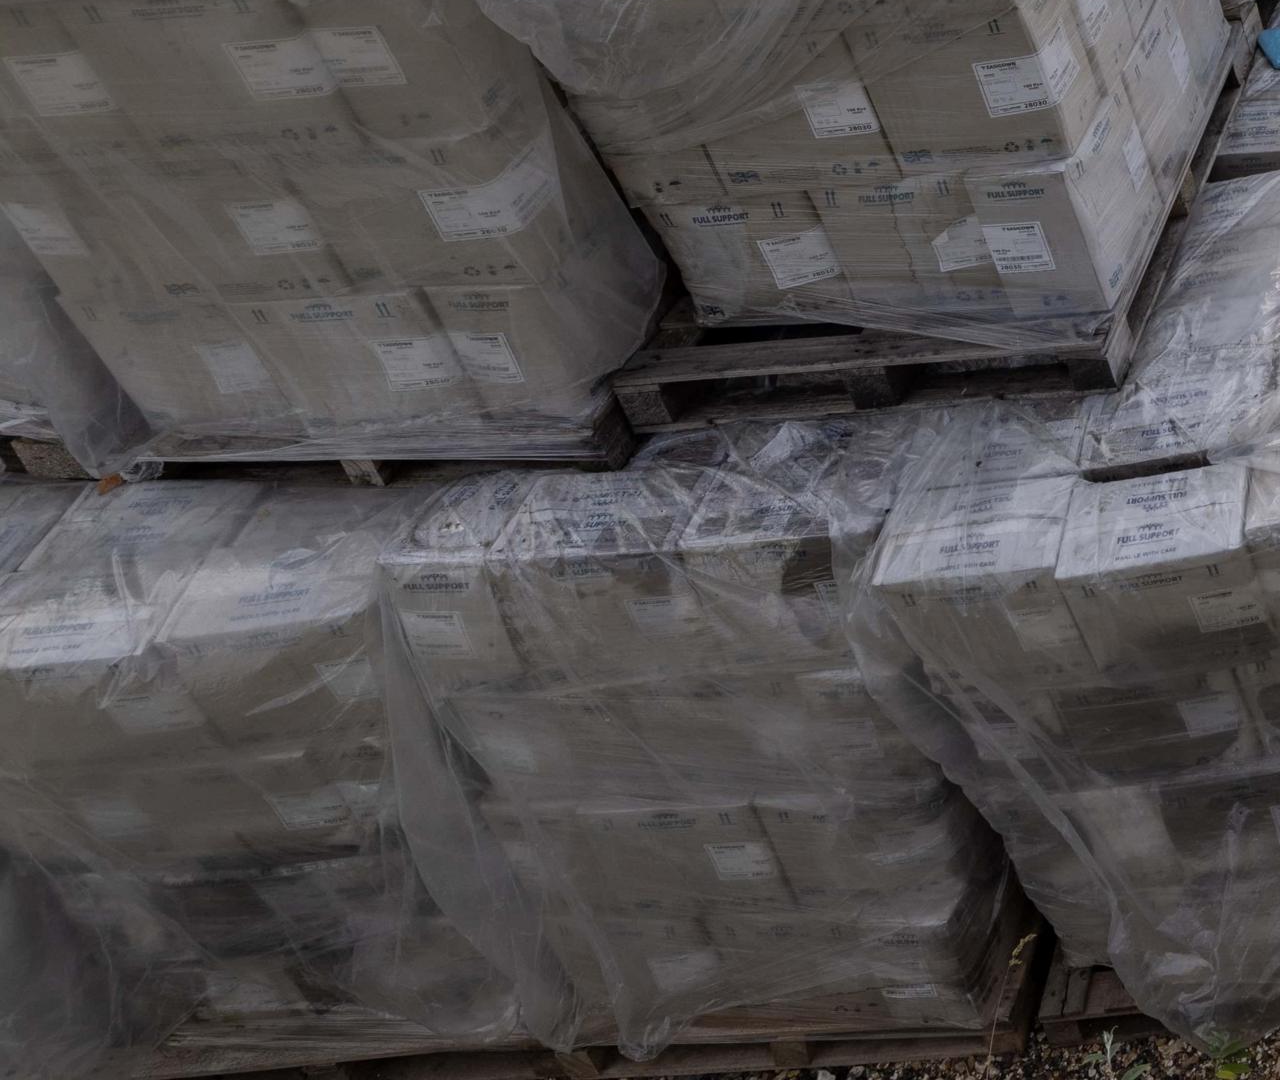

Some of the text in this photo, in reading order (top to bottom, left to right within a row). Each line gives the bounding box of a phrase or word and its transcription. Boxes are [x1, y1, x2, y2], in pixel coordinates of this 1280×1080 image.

[1024, 100, 1048, 109] 28030
[858, 192, 915, 203] FULL SUPPORT
[987, 188, 1045, 200] FULL SUPPORT
[692, 212, 750, 224] FULL SUPPORT
[1116, 527, 1180, 545] FULL SUPPORT
[403, 581, 470, 591] FULL SUPPORT
